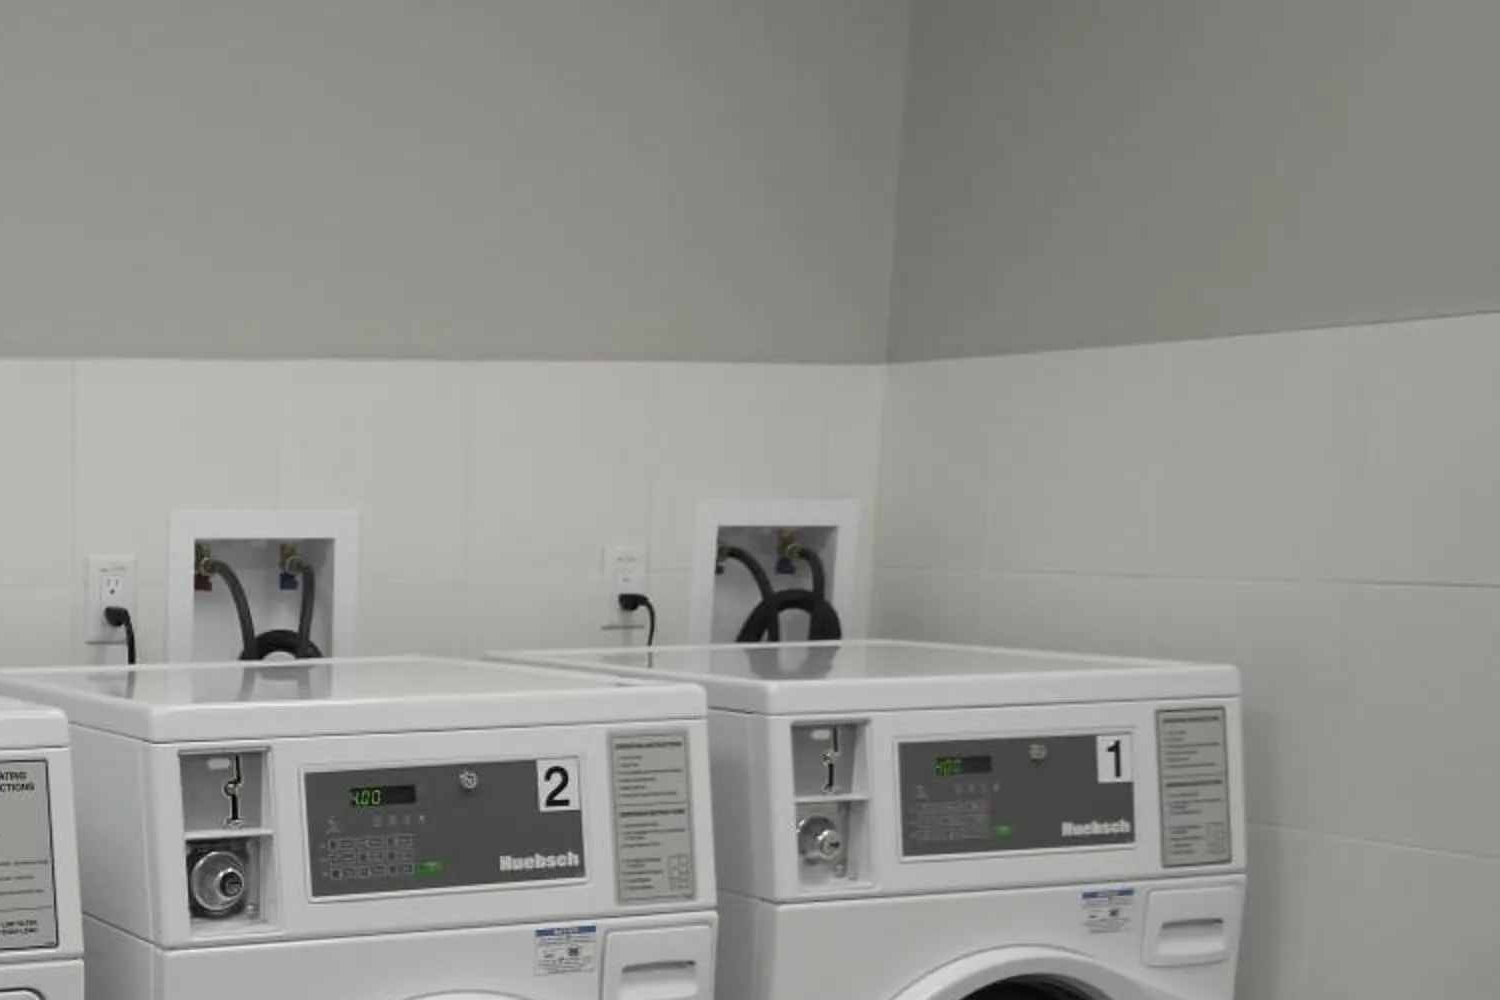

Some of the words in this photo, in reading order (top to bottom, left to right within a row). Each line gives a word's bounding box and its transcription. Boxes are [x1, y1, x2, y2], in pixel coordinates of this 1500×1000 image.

[1106, 739, 1122, 778] 1
[543, 764, 570, 808] 2
[499, 850, 580, 872] Huebsch
